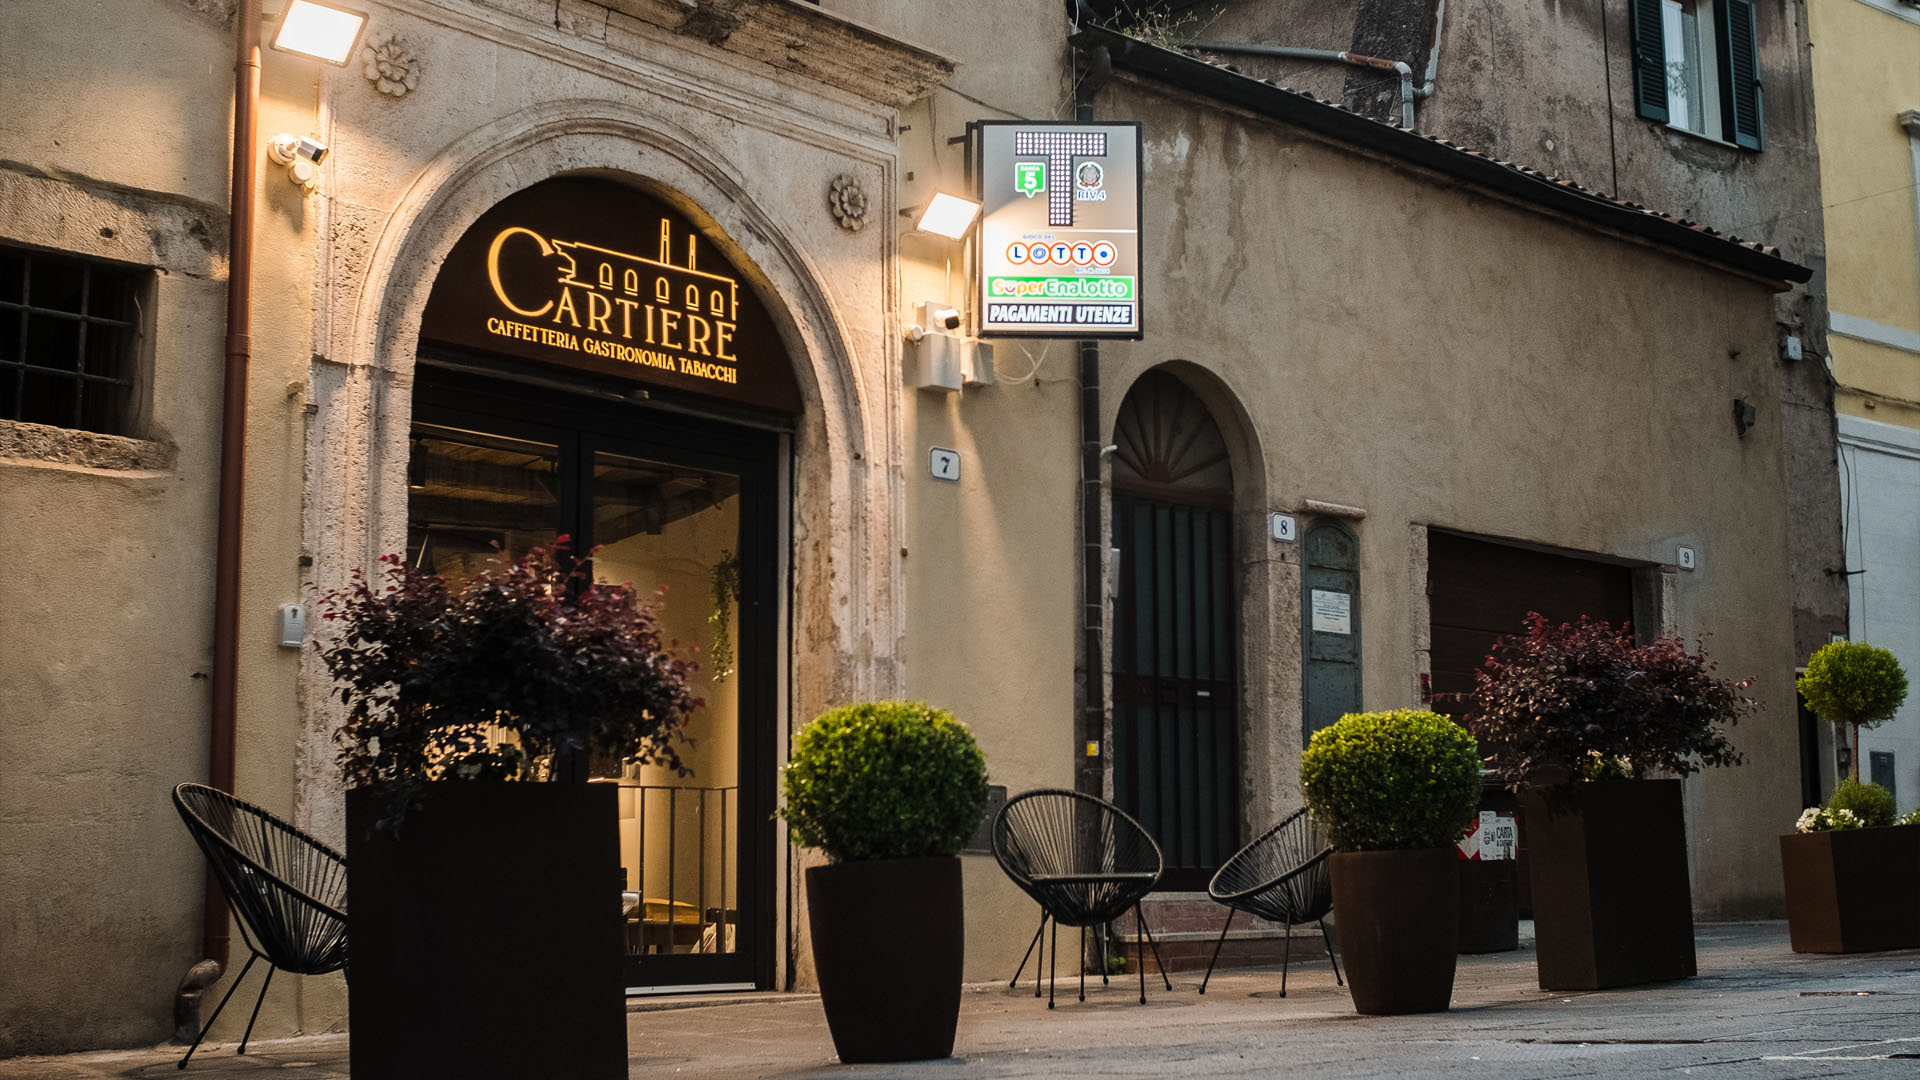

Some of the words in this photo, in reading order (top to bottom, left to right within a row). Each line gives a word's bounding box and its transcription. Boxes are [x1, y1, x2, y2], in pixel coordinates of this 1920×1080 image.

[1016, 132, 1107, 226] T
[1024, 172, 1037, 189] 5
[1007, 243, 1115, 264] LOTTO
[487, 226, 737, 362] CARTIERE
[993, 279, 1126, 296] SuperEnalotto
[990, 304, 1072, 322] PAGAMENTI
[1075, 305, 1131, 323] UTENZE
[487, 317, 579, 351] CAFFETTERIA
[583, 338, 675, 371] GASTRONOMIA
[678, 357, 737, 384] TABACCHI
[941, 456, 950, 473] 7
[1281, 520, 1288, 535] 8
[1684, 551, 1690, 564] 9
